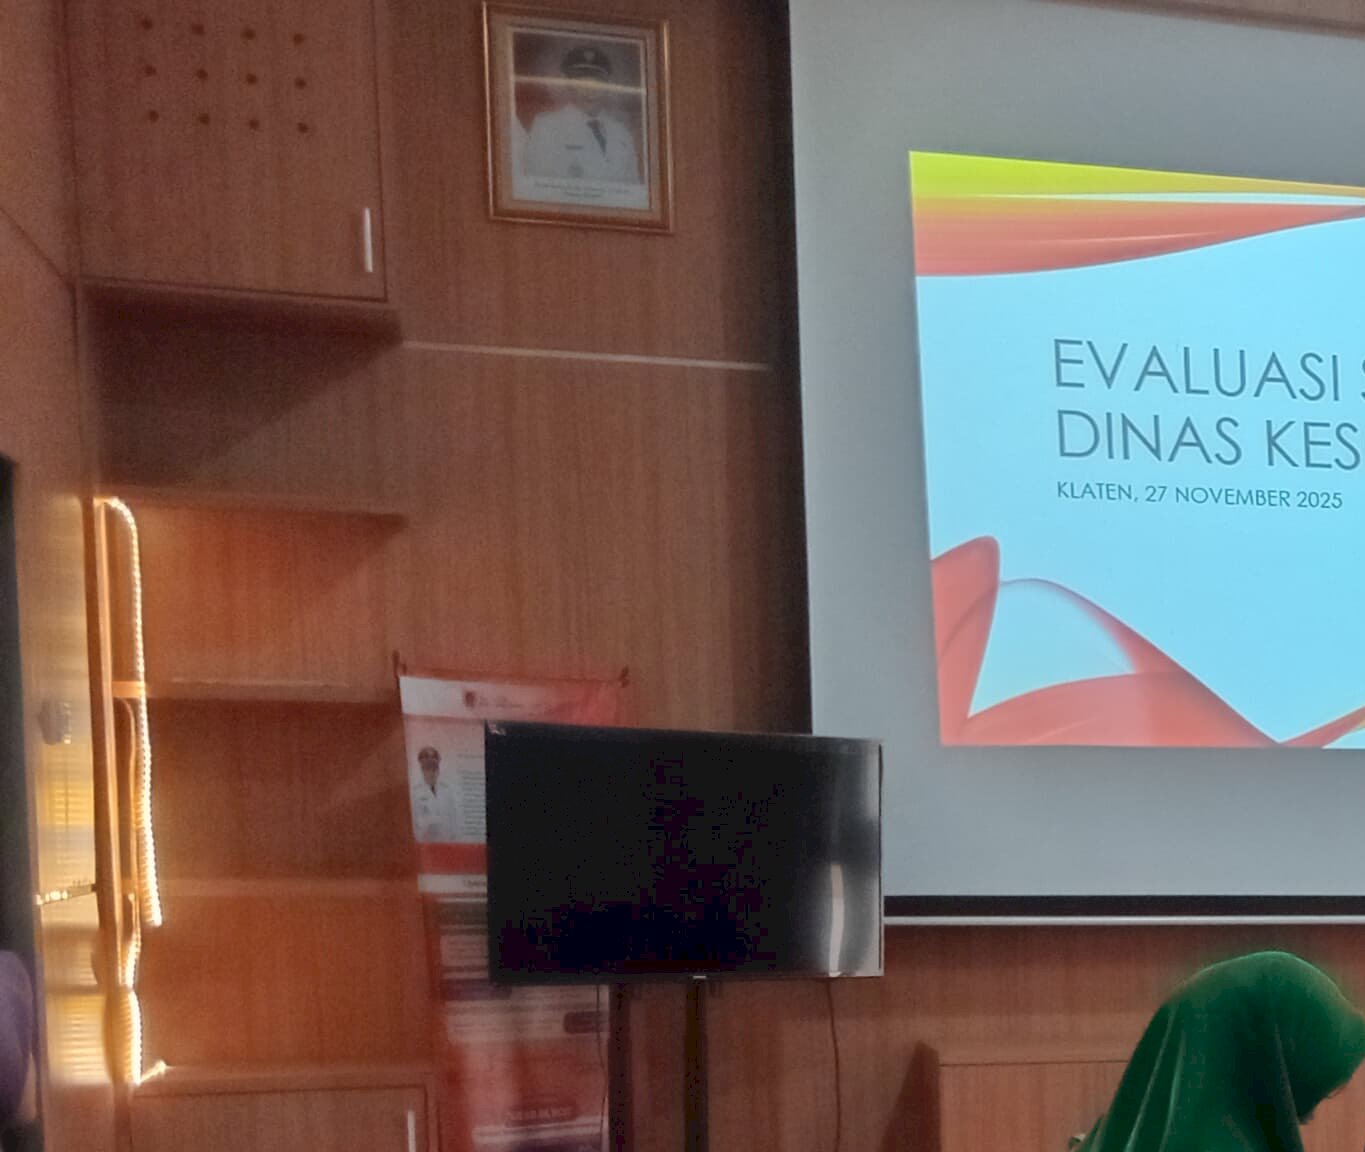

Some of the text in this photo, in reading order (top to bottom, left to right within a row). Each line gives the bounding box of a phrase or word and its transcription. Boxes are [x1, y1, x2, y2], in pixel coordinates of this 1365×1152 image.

[1053, 338, 1340, 402] EVALUASI
[1056, 408, 1243, 466] DINAS
[1057, 480, 1344, 510] KLATEN, 27 NOVEMBER 2025
